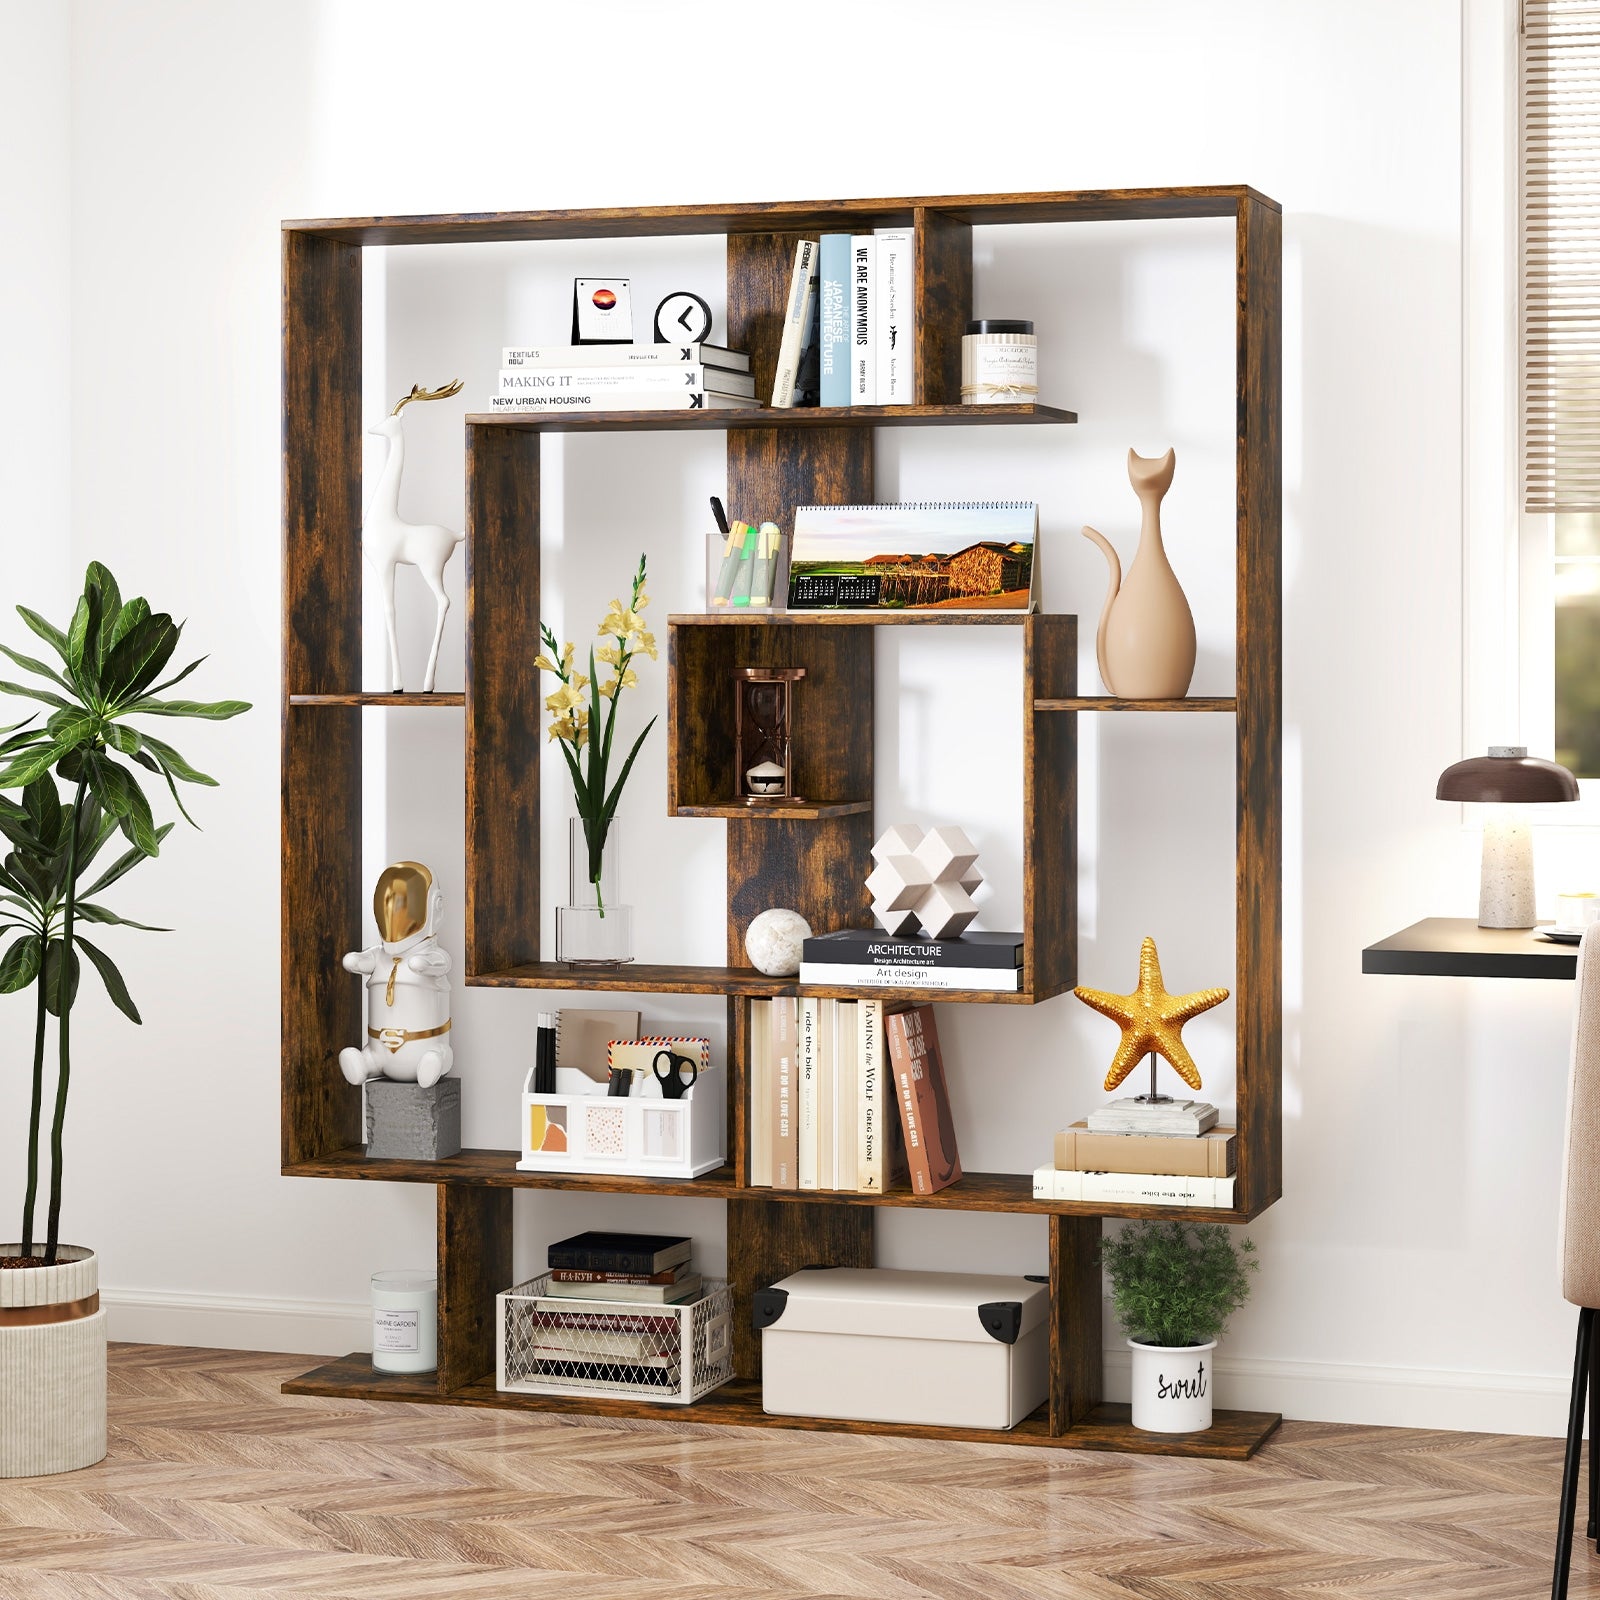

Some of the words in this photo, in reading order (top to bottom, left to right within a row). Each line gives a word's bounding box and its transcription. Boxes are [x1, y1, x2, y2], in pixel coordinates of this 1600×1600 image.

[856, 248, 867, 263] WE
[856, 265, 867, 284] ARE
[832, 280, 843, 343] JAPANESE
[856, 286, 867, 346] ANONYMOUS
[823, 280, 833, 375] ARCHITECTURE
[503, 376, 555, 387] MAKING
[559, 376, 573, 386] IT
[515, 397, 547, 405] URBAN
[549, 396, 591, 405] HOUSING
[867, 944, 942, 956] ARCHITECTURE
[874, 957, 892, 965] Design
[876, 968, 891, 977] Art
[894, 968, 928, 979] design
[865, 1003, 875, 1050] TAMING
[780, 1057, 788, 1074] WHY
[865, 1052, 873, 1065] the
[780, 1075, 788, 1085] DO
[865, 1067, 875, 1101] WOLF
[900, 1073, 909, 1089] WHY
[780, 1086, 788, 1098] WE
[903, 1089, 911, 1100] DO
[780, 1099, 788, 1118] LOVE
[904, 1101, 912, 1112] WE
[780, 1119, 788, 1137] CATS
[906, 1112, 915, 1130] LOVE
[910, 1129, 918, 1148] CATS
[1157, 1360, 1208, 1400] sweet
